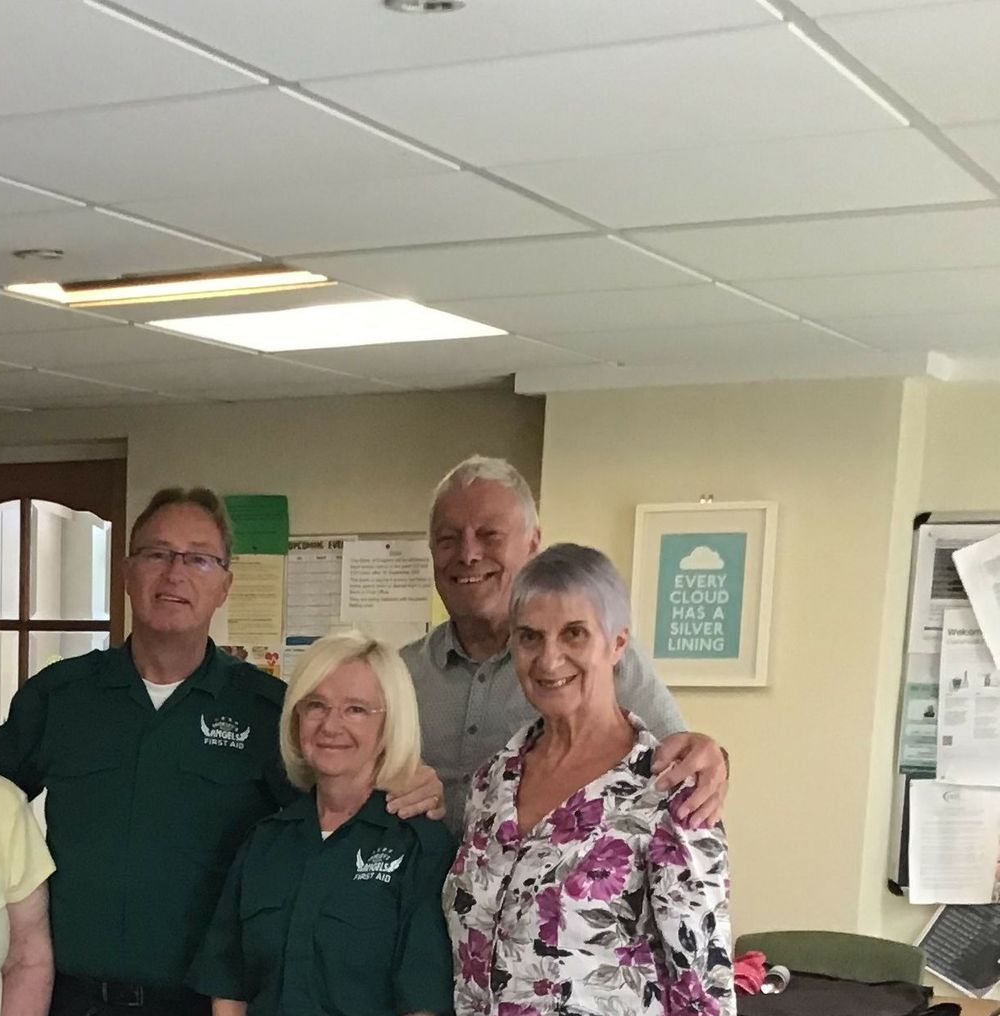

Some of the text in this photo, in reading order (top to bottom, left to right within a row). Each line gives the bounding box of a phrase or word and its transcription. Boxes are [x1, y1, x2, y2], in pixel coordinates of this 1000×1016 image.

[674, 573, 728, 589] EVERY
[669, 590, 729, 605] CLOUD
[672, 606, 725, 620] HAS A
[670, 622, 724, 636] SILVER
[668, 637, 725, 652] LINING
[204, 738, 245, 750] FIRST AID
[353, 872, 391, 883] FIRST AID
